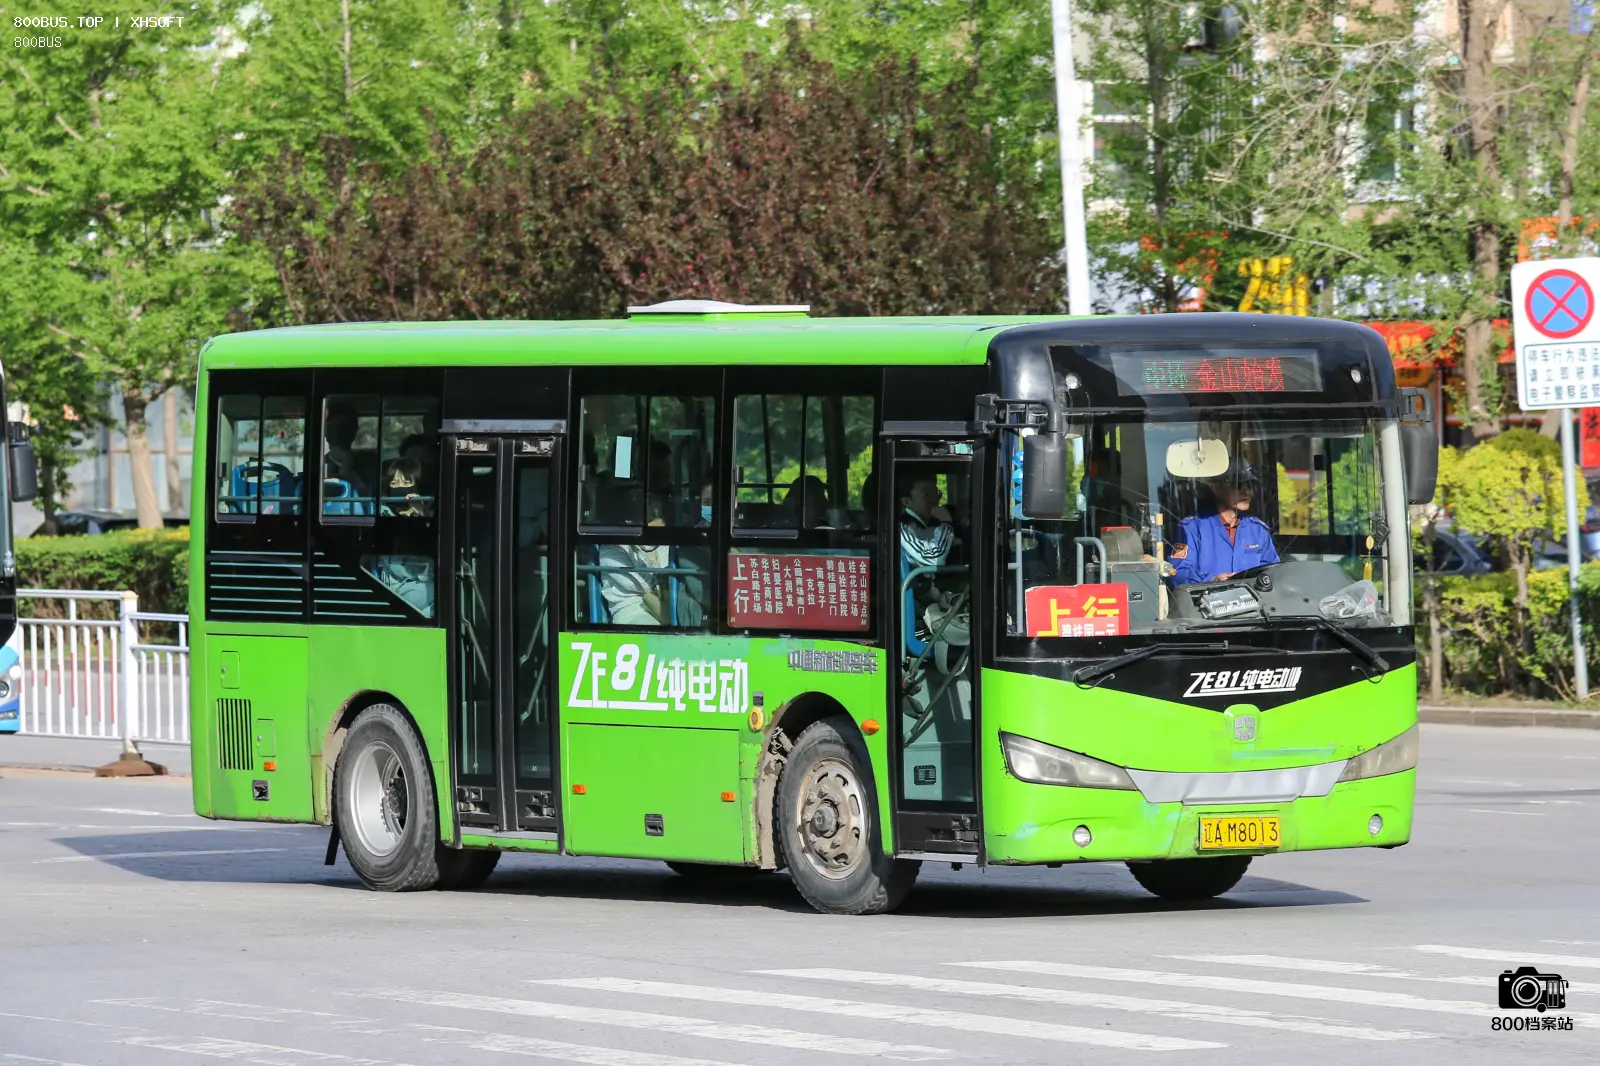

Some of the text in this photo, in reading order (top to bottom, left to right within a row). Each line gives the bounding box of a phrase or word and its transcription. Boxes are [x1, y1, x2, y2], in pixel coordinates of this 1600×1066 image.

[1196, 357, 1285, 391] 金山始发
[733, 557, 750, 613] 上行
[750, 558, 762, 613] 苏白路市场
[772, 558, 784, 614] 妇婴医院
[783, 565, 794, 607] 大润发
[805, 568, 816, 605] 一克拉
[816, 567, 827, 608] 南营子
[826, 560, 838, 616] 碧桂园正门
[838, 560, 849, 616] 血栓医院
[848, 560, 859, 617] 桂花市场
[859, 561, 868, 617] 金山终点
